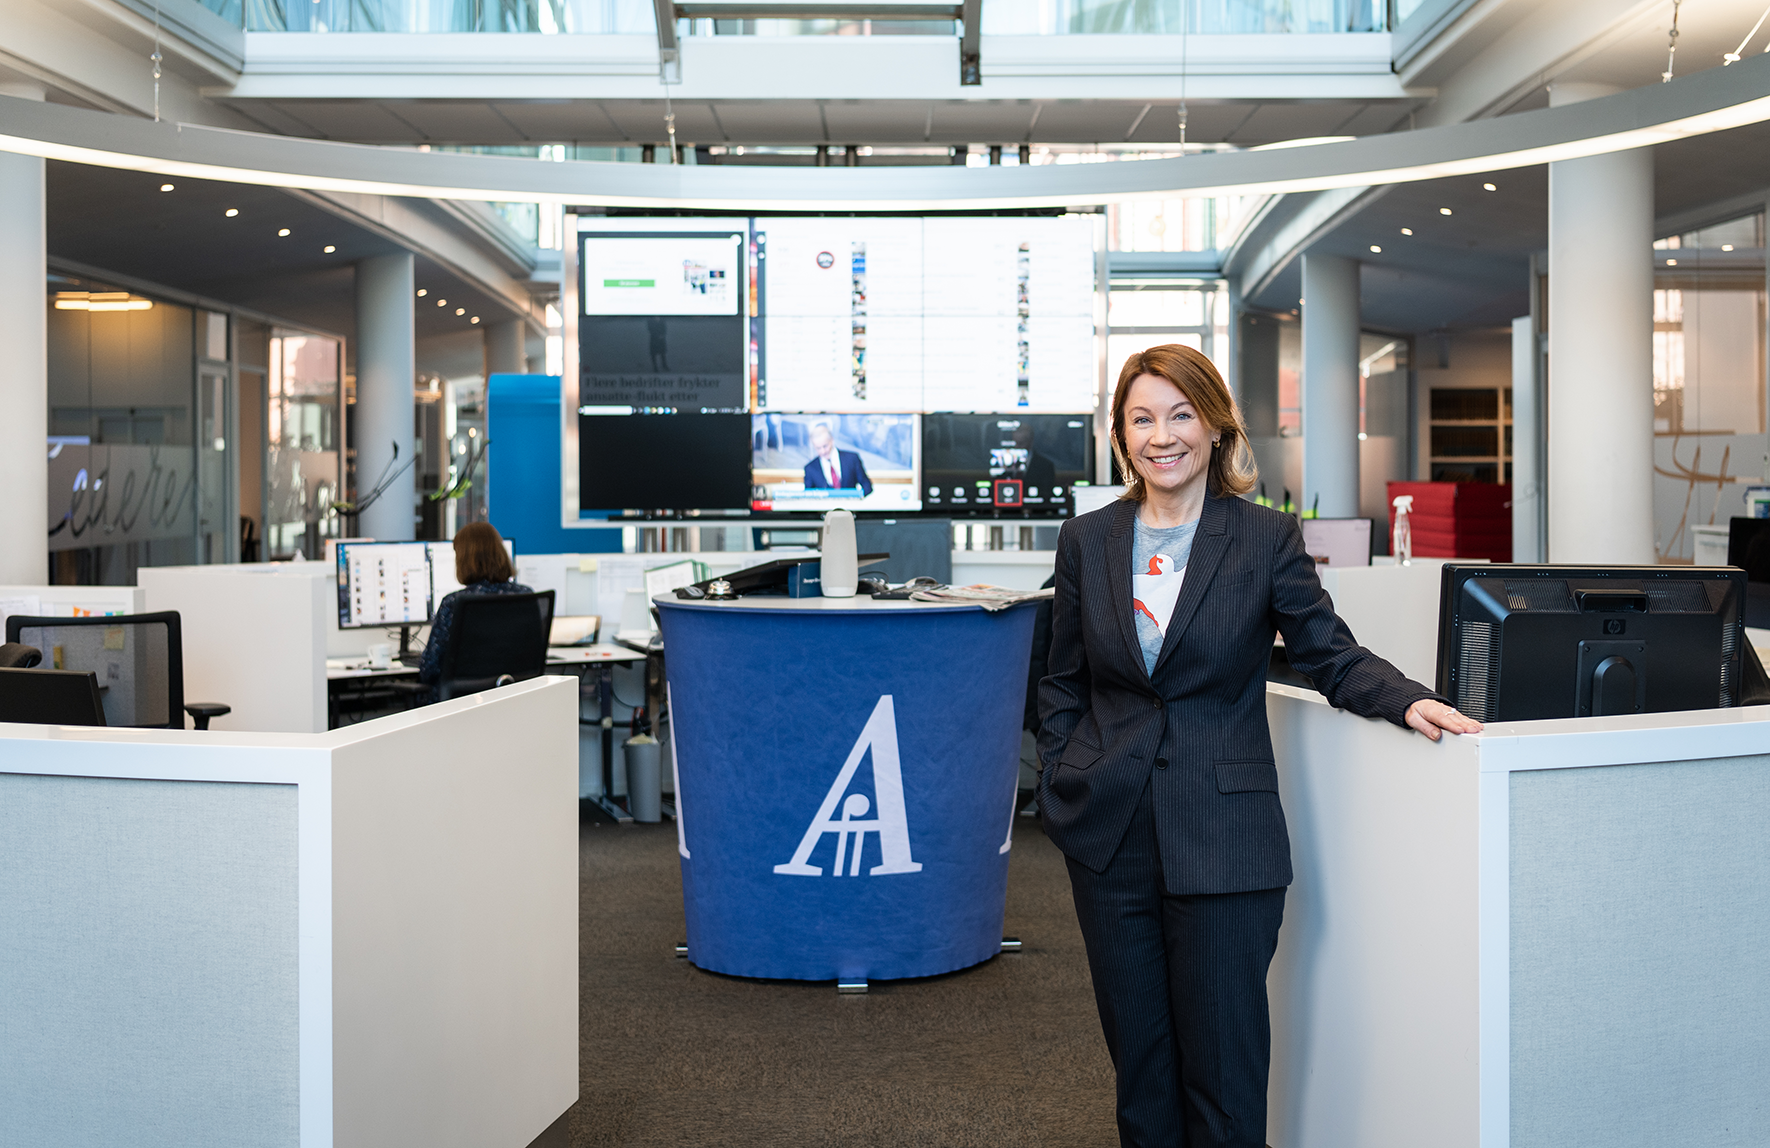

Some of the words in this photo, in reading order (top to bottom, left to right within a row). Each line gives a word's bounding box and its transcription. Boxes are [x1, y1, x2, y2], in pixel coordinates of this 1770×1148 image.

[586, 377, 617, 388] Flere
[619, 377, 675, 388] bedrifter
[677, 377, 720, 390] frykter
[669, 392, 698, 402] etter
[1609, 619, 1621, 634] hp
